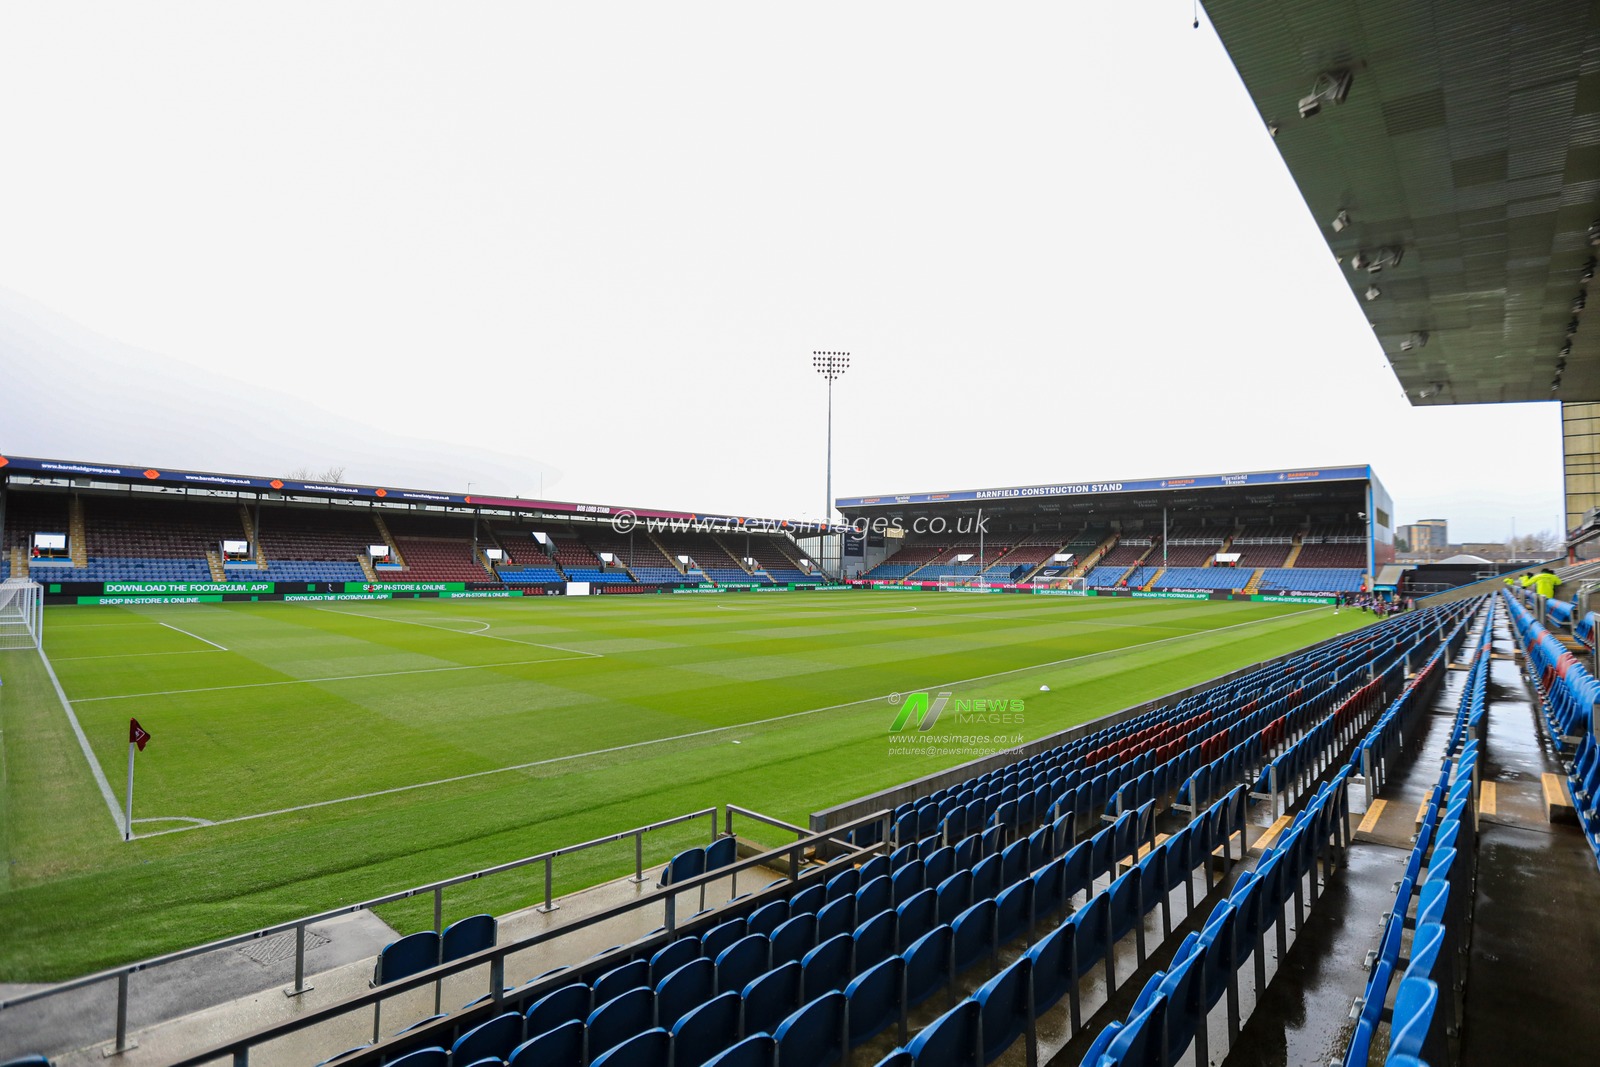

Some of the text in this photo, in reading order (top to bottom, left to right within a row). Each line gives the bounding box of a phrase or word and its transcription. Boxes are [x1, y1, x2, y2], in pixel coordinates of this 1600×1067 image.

[976, 483, 1123, 499] BARNFIELD CONSTRUCTION STAND
[596, 506, 610, 514] STAND
[106, 584, 167, 592] DOWNLOAD
[168, 584, 188, 592] THE
